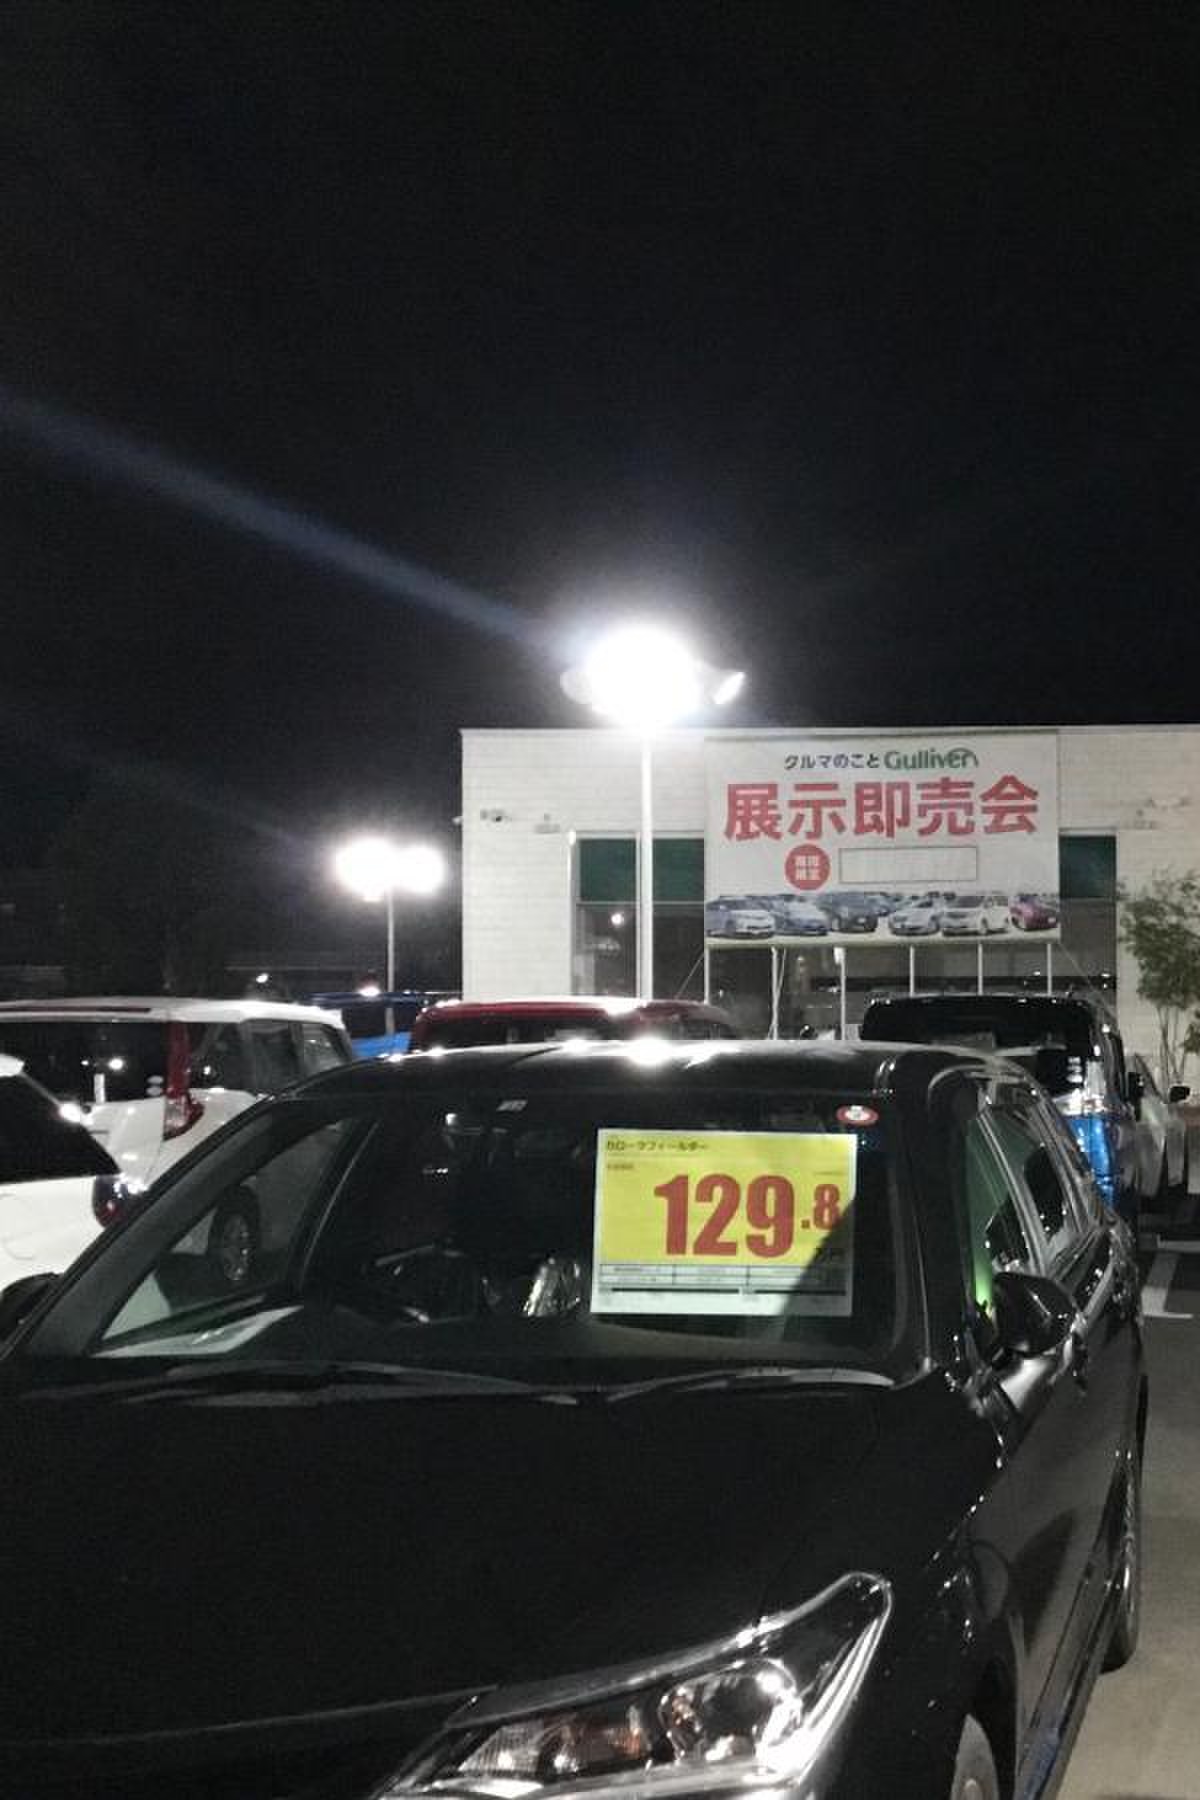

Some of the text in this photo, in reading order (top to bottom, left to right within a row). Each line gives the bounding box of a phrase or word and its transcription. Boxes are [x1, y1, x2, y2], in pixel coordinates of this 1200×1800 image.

[784, 748, 979, 770] クルマのこと Gulliver
[724, 774, 1039, 841] 展示即売会
[654, 1174, 841, 1258] 129.8
